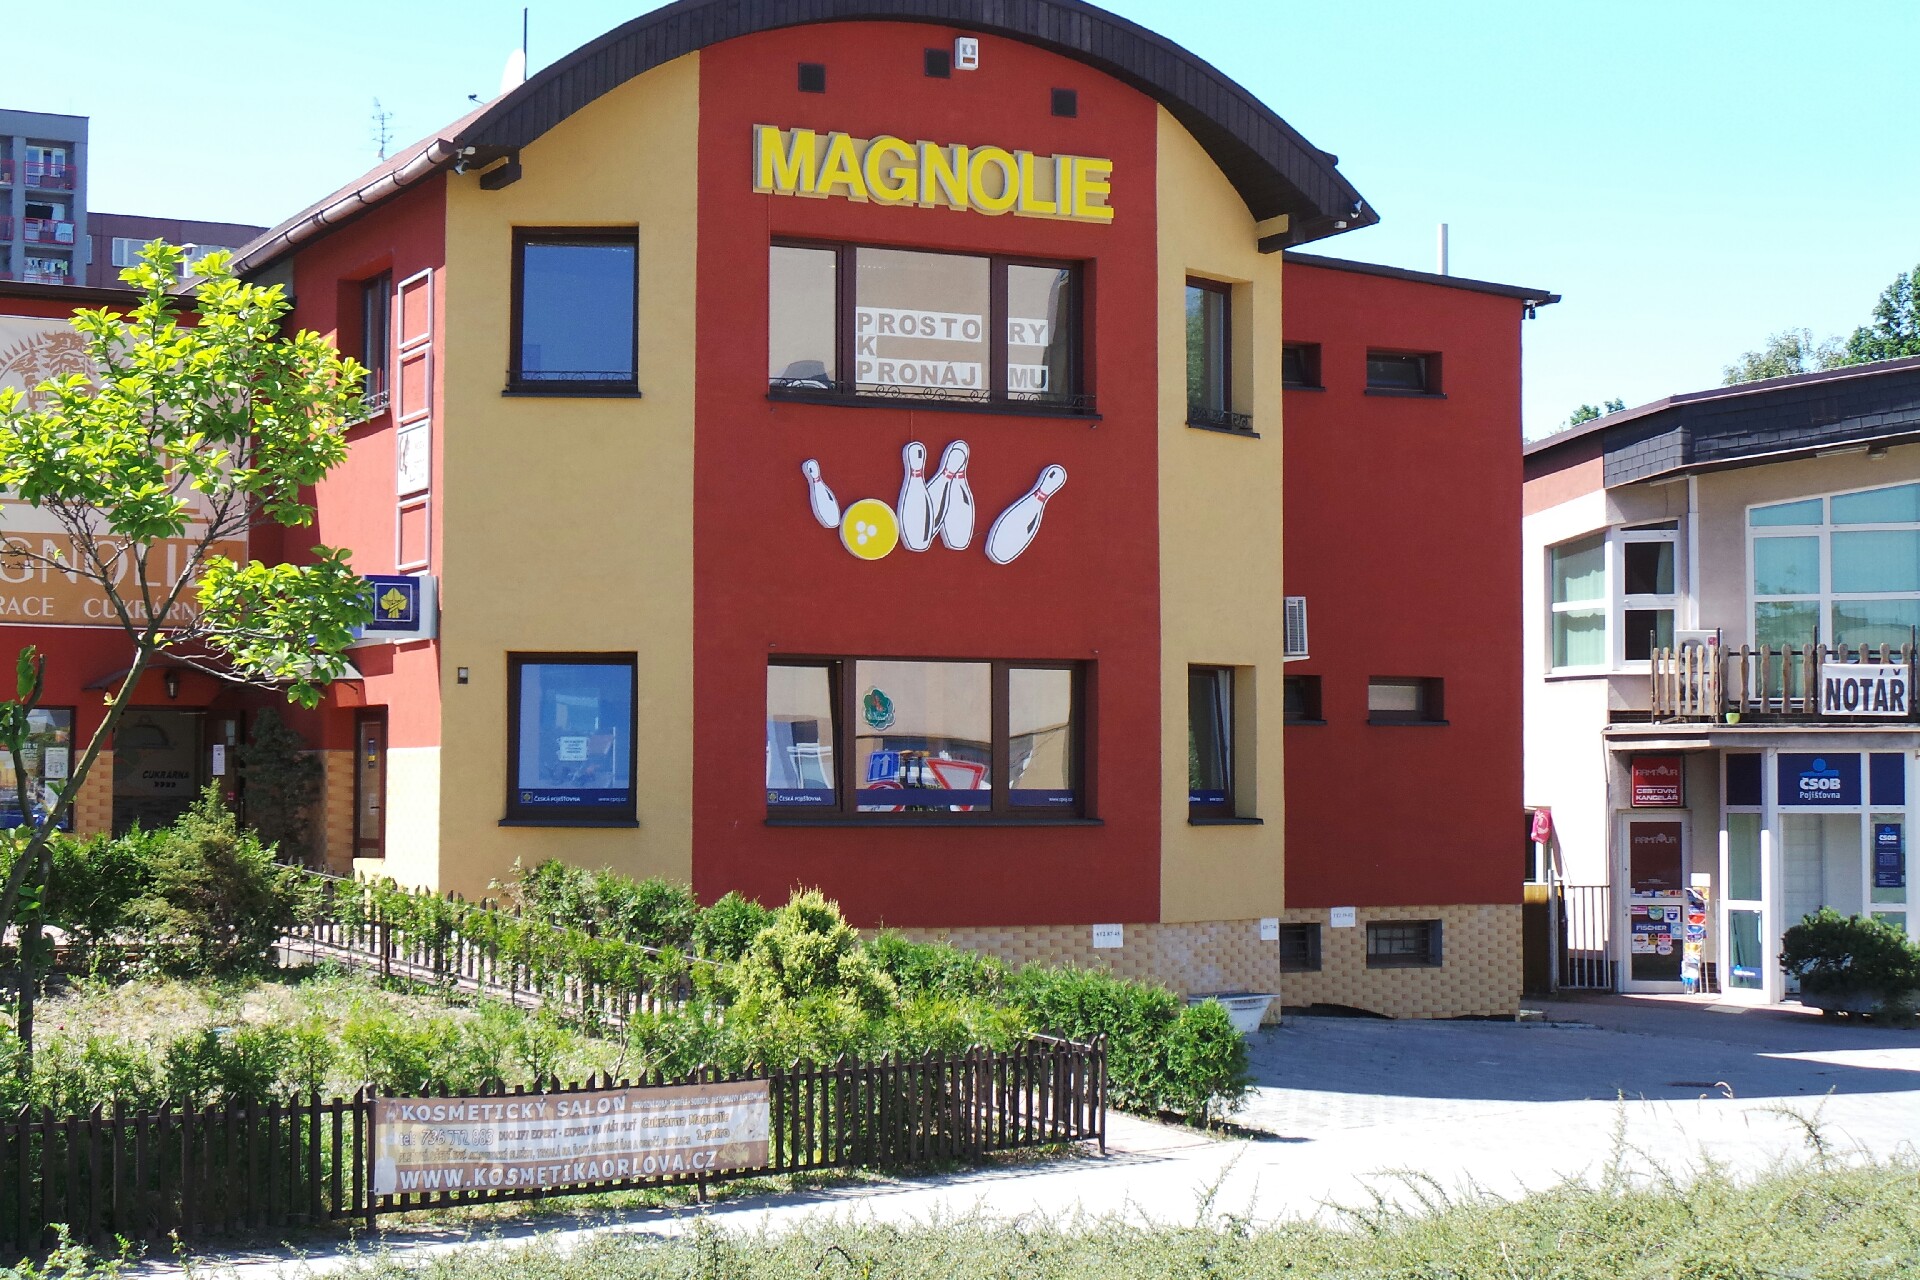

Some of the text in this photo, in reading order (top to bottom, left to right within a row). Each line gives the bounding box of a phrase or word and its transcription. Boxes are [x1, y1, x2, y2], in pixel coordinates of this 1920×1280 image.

[755, 125, 1114, 221] MAGNOLIE
[857, 335, 876, 356] K
[83, 595, 198, 620] CUKRÁRN
[1825, 668, 1905, 712] NOTÁŘ
[1799, 777, 1841, 790] ČSOB
[401, 1101, 547, 1122] KOSMETICKÝ
[556, 1095, 626, 1117] SALON
[421, 1129, 446, 1146] 736
[401, 1151, 718, 1190] WWW.KOSMETIKAORLOVA.CZ
